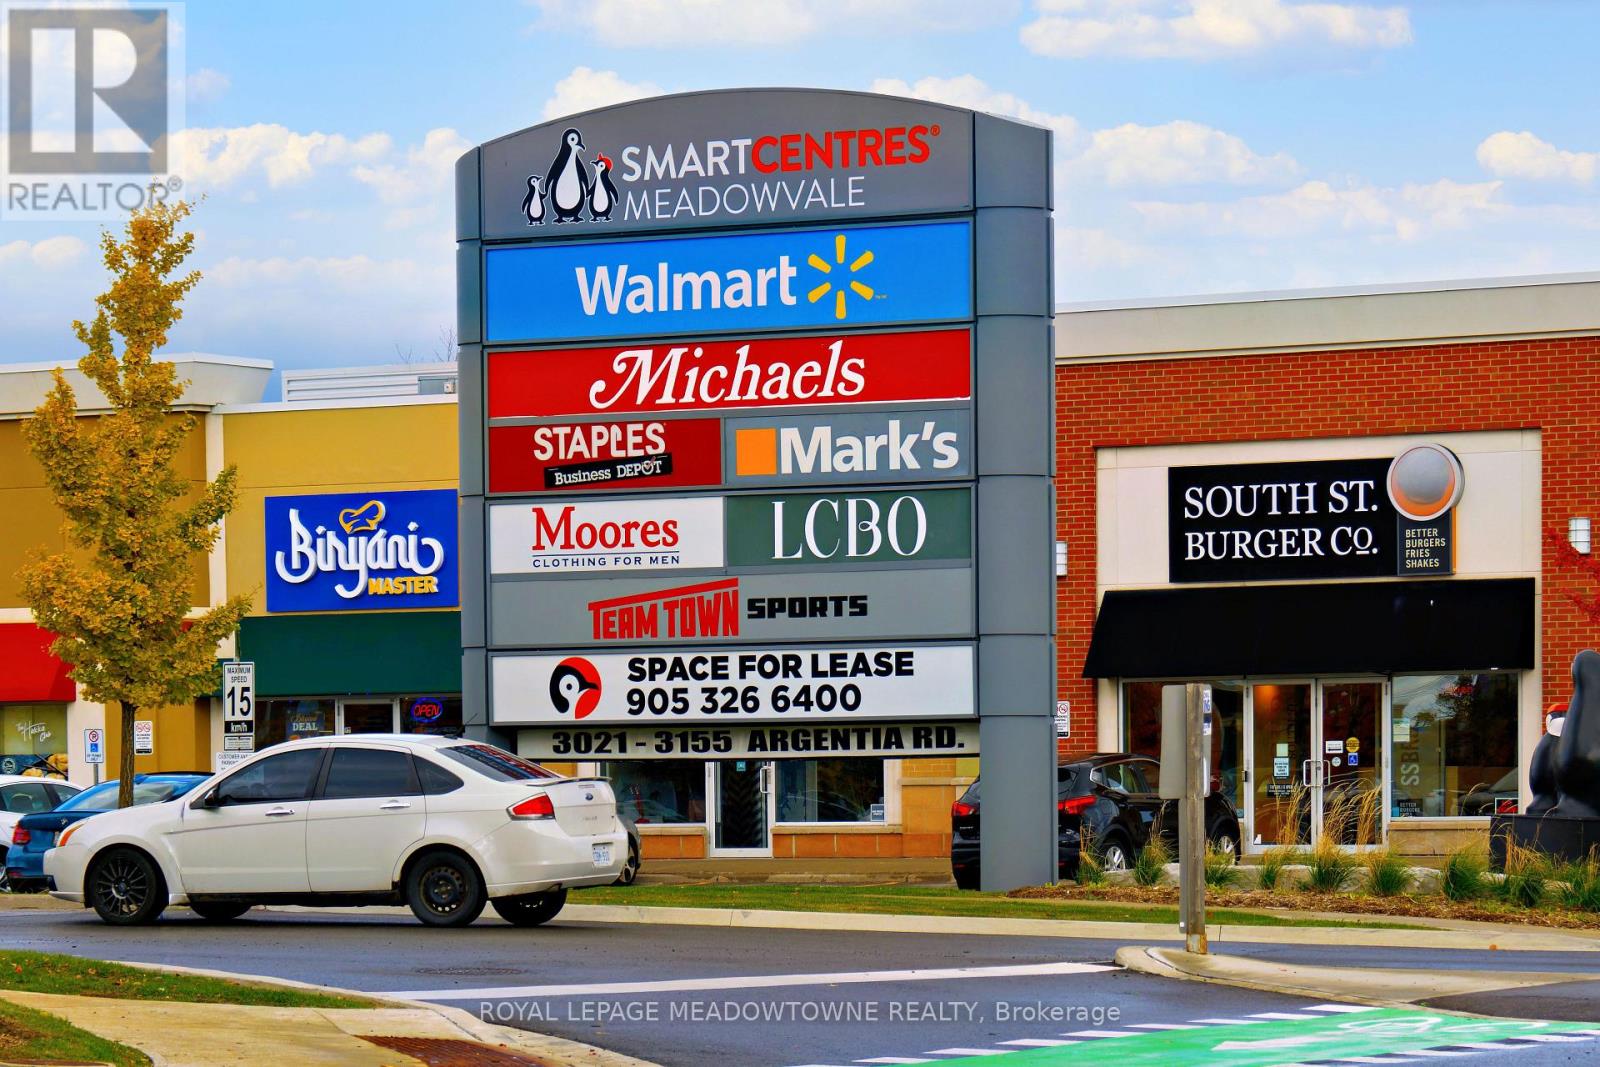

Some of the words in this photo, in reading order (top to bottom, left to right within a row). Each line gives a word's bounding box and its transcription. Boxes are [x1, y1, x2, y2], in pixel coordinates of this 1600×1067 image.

[624, 176, 866, 221] MEADOWVALE
[575, 255, 797, 316] Walmart
[589, 340, 866, 408] Michaels
[533, 422, 667, 461] STAPLES
[780, 420, 959, 475] Mark's
[554, 468, 612, 485] Business
[617, 459, 662, 478] DEPOT
[1184, 482, 1317, 519] SOUTH
[1328, 480, 1378, 514] ST.
[532, 506, 680, 550] Moores
[771, 495, 927, 559] LCBO
[1405, 528, 1438, 538] BETTER
[275, 508, 444, 599] Biryani
[1184, 527, 1325, 561] BURGER
[1405, 538, 1446, 548] BURGERS
[1405, 549, 1430, 558] FRIES
[532, 556, 607, 568] CLOTHING
[614, 556, 642, 566] FOR
[649, 555, 680, 565] MEN
[1405, 558, 1440, 568] SHAKES
[367, 575, 439, 595] MASTER
[588, 597, 659, 640] TEAM
[663, 578, 740, 639] TOWN
[747, 595, 868, 619] SPORTS
[228, 666, 251, 675] MAXIMUM
[230, 676, 248, 684] SPEED
[626, 656, 730, 683] SPACE
[738, 654, 803, 680] FOR
[809, 651, 914, 679] LEASE
[227, 686, 251, 717] 15
[414, 703, 440, 717] OPEN
[626, 688, 690, 716] 905
[700, 685, 761, 714] 326
[770, 684, 862, 713] 6400
[292, 722, 318, 732] DEAL
[552, 731, 627, 754] 3021
[654, 728, 733, 753] 3155
[747, 726, 906, 752] ARGENTIA
[912, 725, 965, 750] RD.
